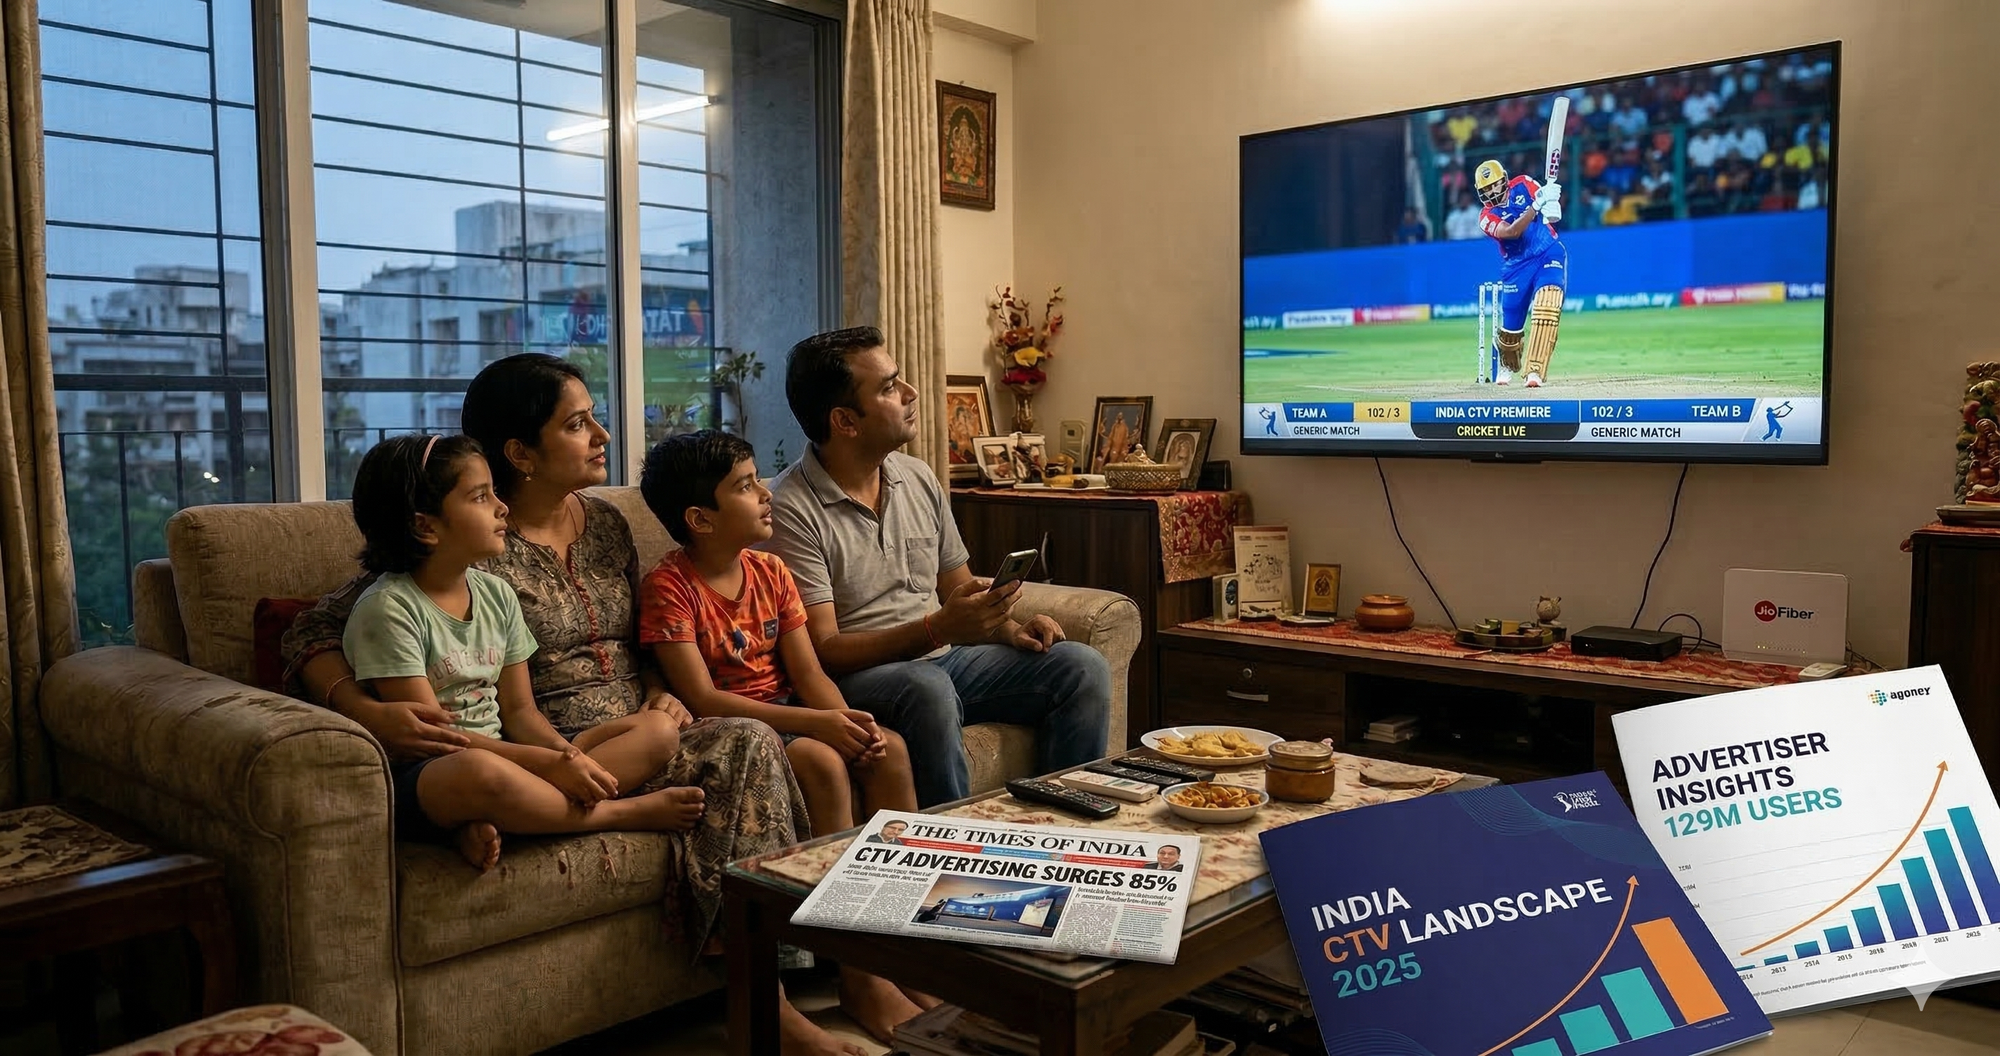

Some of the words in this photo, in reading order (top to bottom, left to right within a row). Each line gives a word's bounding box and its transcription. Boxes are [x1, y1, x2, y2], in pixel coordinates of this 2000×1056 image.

[1291, 407, 1316, 419] TEAM
[1316, 407, 1328, 419] A
[1366, 407, 1386, 419] 102
[1393, 407, 1401, 418] 3
[1435, 406, 1466, 419] INDIA
[1467, 406, 1491, 419] CTV
[1493, 405, 1551, 418] PREMIERE
[1591, 405, 1615, 418] 102
[1624, 406, 1634, 418] 3
[1691, 404, 1729, 418] TEAM
[1731, 404, 1742, 418] B
[1293, 426, 1329, 436] GENERIC
[1330, 426, 1360, 436] MATCH
[1456, 425, 1501, 437] CRICKET
[1502, 425, 1526, 437] LIVE
[1590, 426, 1637, 438] GENERIC
[1640, 427, 1682, 439] MATCH
[1651, 731, 1830, 783] ADVERTISER
[1655, 765, 1795, 811] INSIGHTS
[1663, 803, 1742, 838] 129M
[1746, 786, 1843, 821] USERS
[911, 823, 958, 840] THE
[964, 828, 1037, 848] TIMES
[1040, 836, 1075, 851] OF
[1078, 839, 1147, 858] INDIA
[853, 846, 901, 865] CTV
[897, 850, 1038, 879] ADVERTISING
[1040, 864, 1126, 888] SURGES
[1128, 872, 1178, 893] 85%
[1310, 886, 1412, 932] INDIA
[1322, 922, 1390, 964] CTV
[1399, 877, 1613, 945] LANDSCAPE
[1331, 950, 1423, 999] 2025
